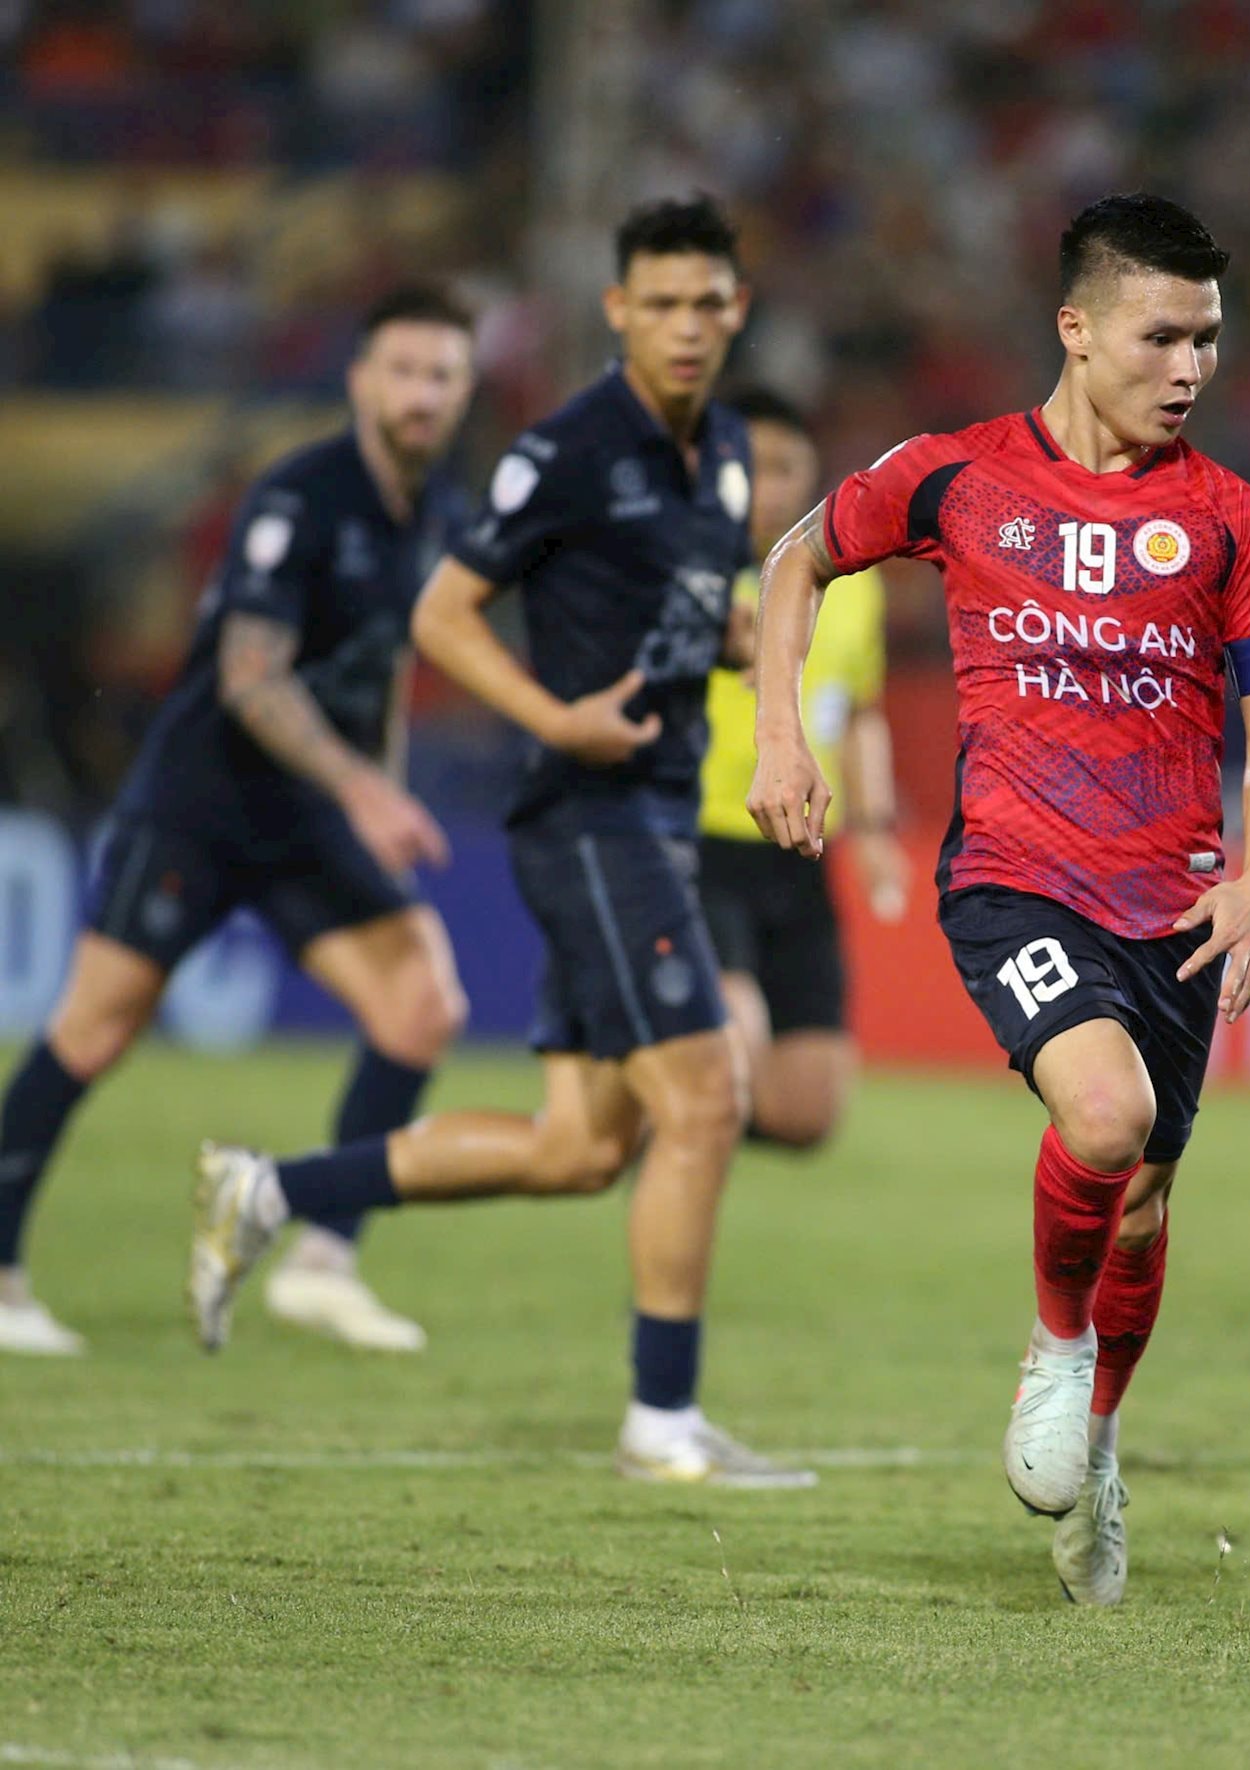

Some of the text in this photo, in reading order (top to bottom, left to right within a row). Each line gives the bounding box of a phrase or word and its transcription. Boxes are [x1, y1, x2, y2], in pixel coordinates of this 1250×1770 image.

[1058, 521, 1117, 595] 19
[988, 599, 1196, 659] CÔNG AN
[1015, 657, 1178, 719] HÀ NỘI
[996, 936, 1079, 1021] 19
